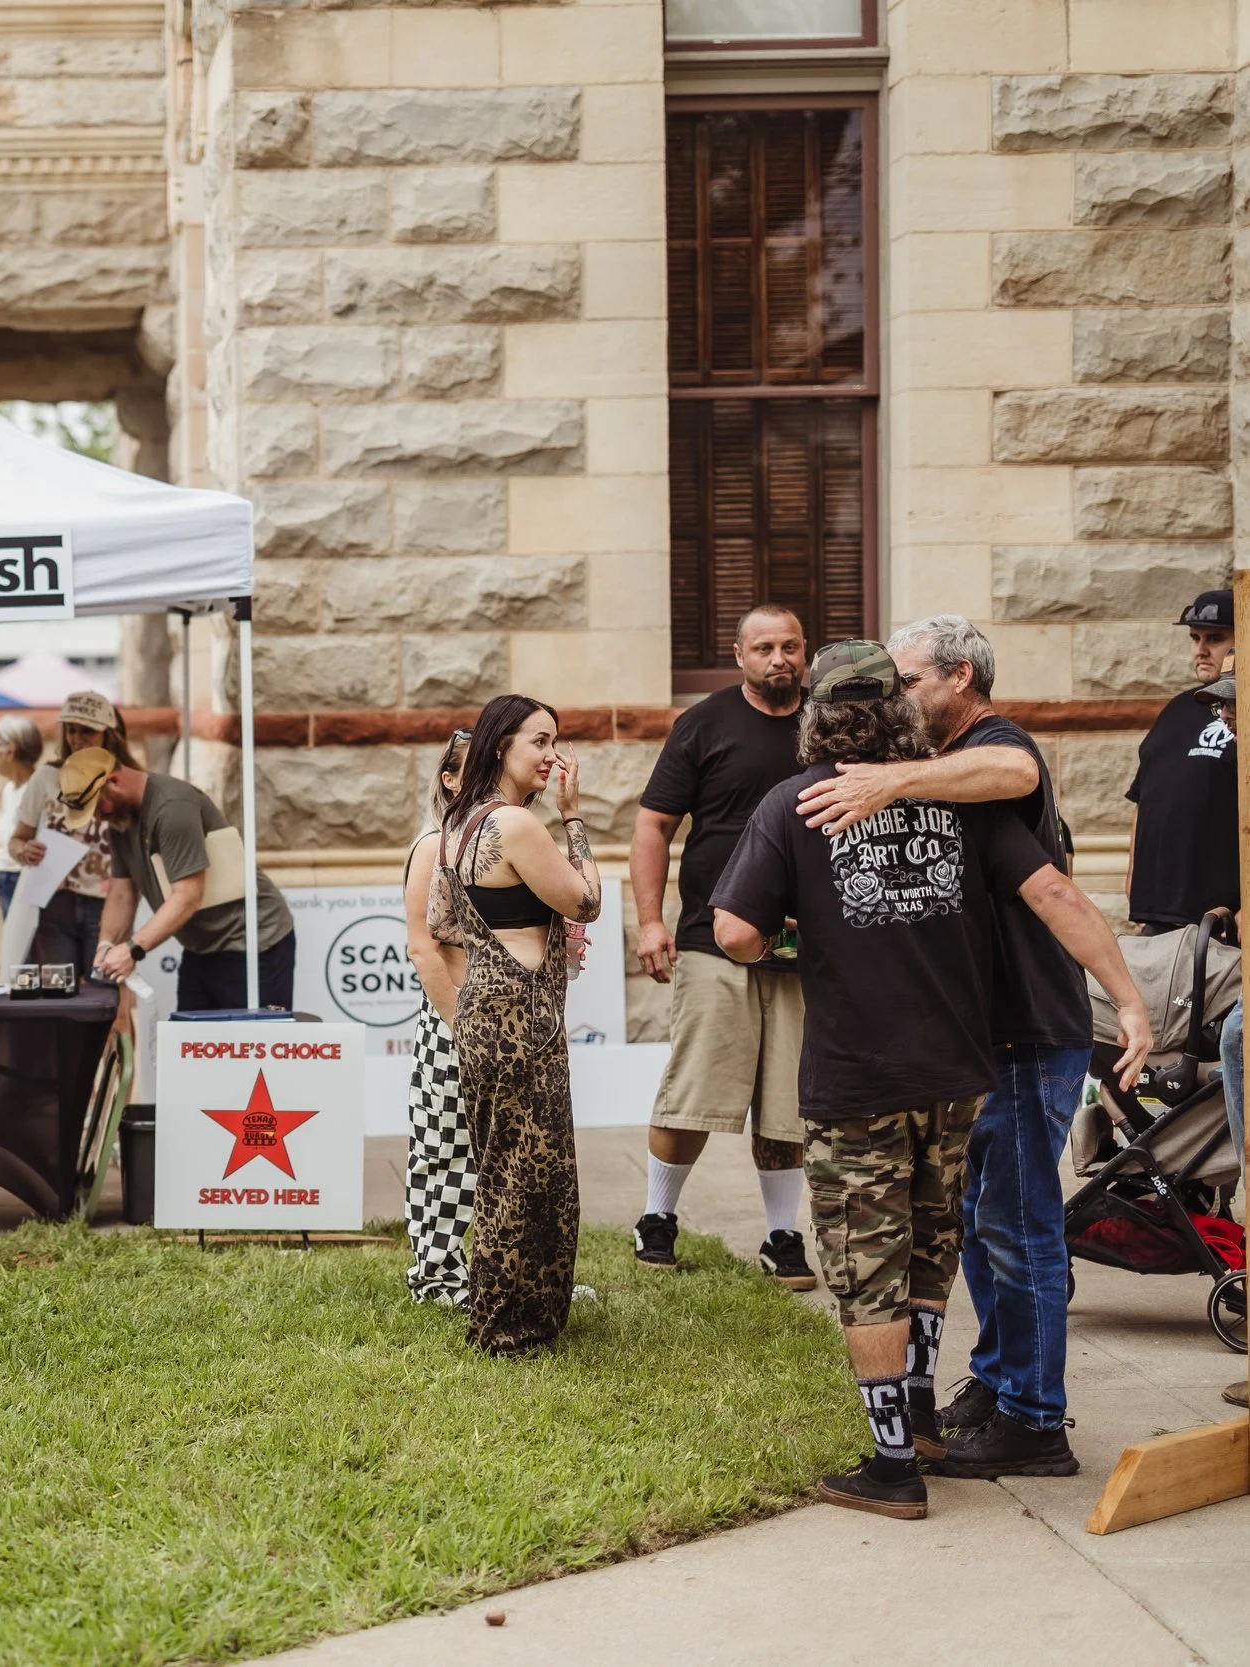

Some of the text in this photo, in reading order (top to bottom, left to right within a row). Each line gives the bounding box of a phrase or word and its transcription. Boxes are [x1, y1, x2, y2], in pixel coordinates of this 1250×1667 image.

[822, 806, 956, 861] ZOMBIE JOE
[857, 842, 899, 870] ART
[341, 972, 423, 993] SONS
[181, 1042, 341, 1060] PEOPLE'S CHOICE
[246, 1115, 274, 1125] TEXAS
[198, 1188, 320, 1205] SERVED HERE
